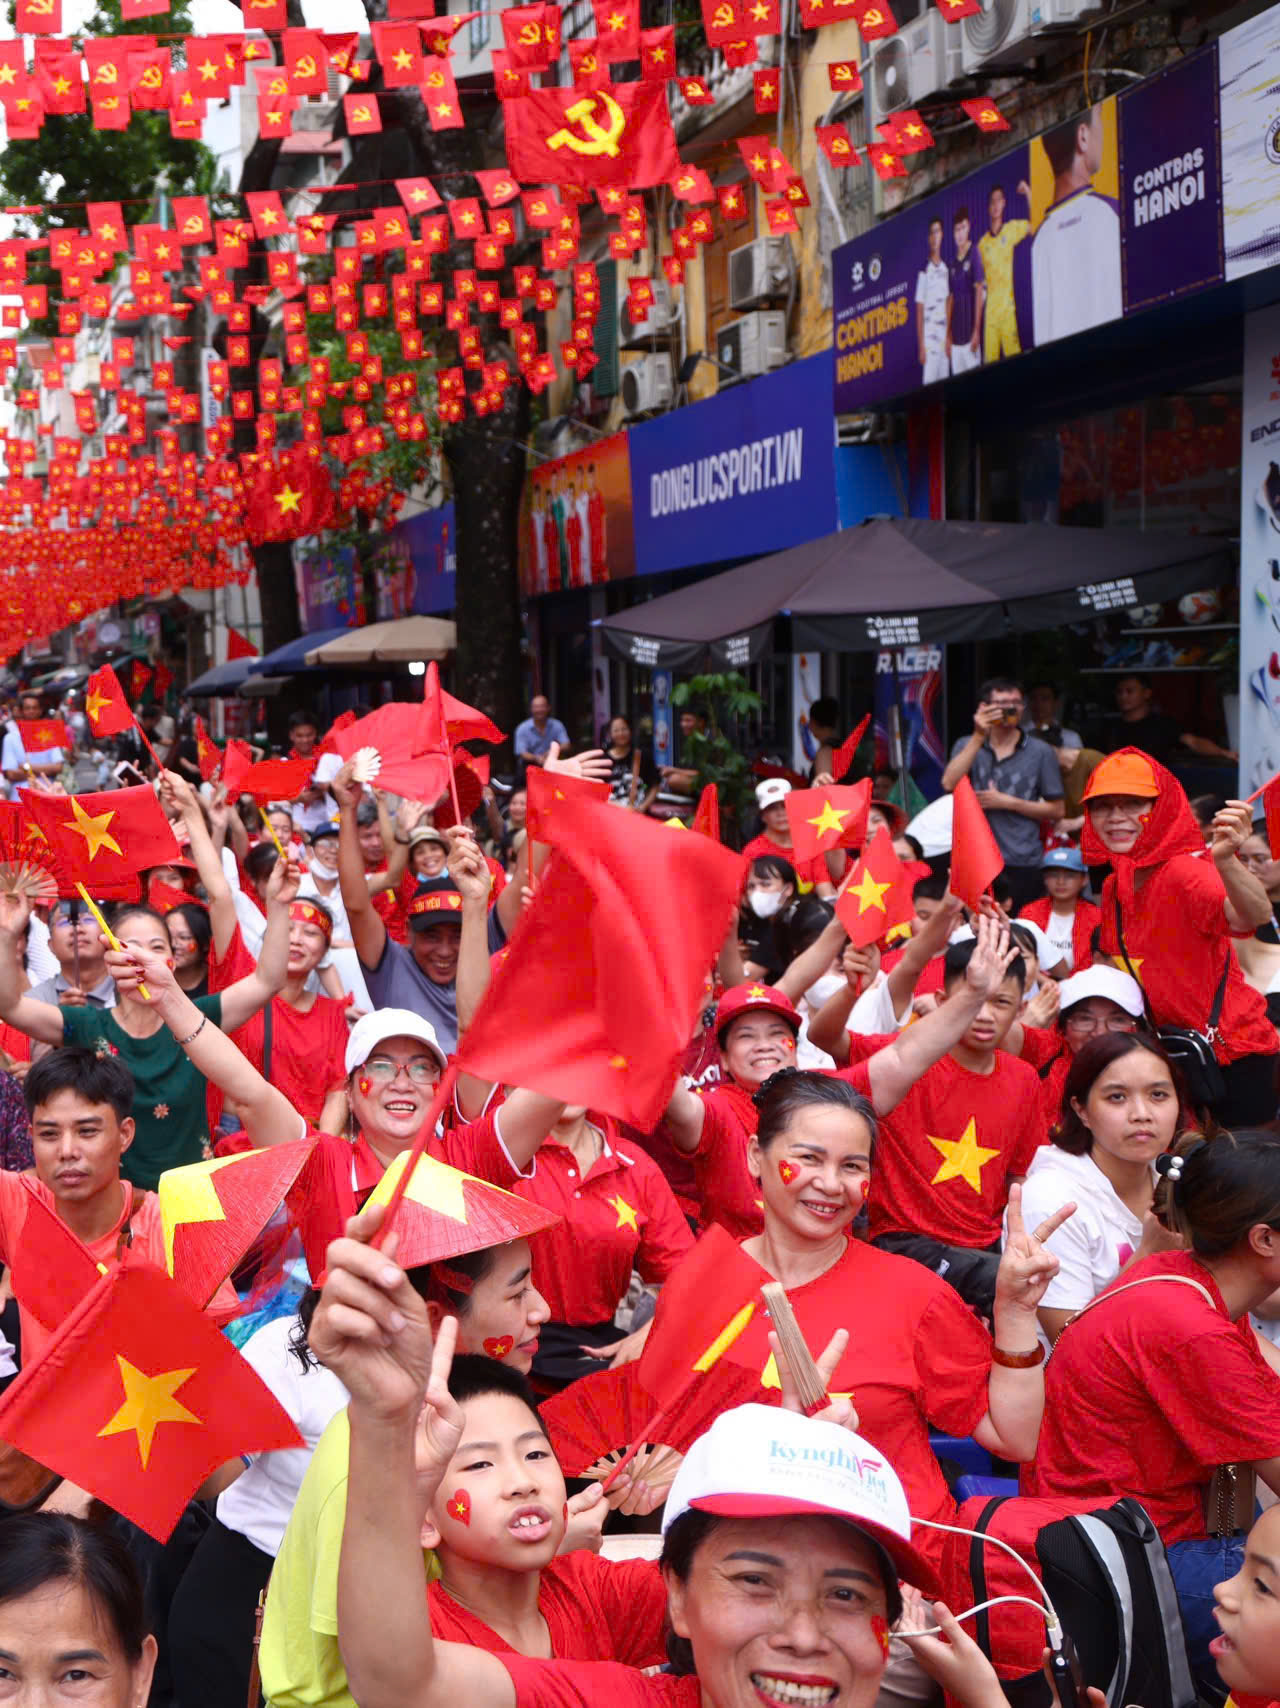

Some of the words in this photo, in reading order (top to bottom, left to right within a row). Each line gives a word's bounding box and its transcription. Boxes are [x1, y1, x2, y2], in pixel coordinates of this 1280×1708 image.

[1133, 147, 1205, 195] CONTRAS
[1133, 169, 1205, 228] HANOI
[836, 295, 908, 350] CONTRAS
[836, 341, 883, 384] HANOI
[650, 427, 803, 519] DONGLUCSPORT.VN
